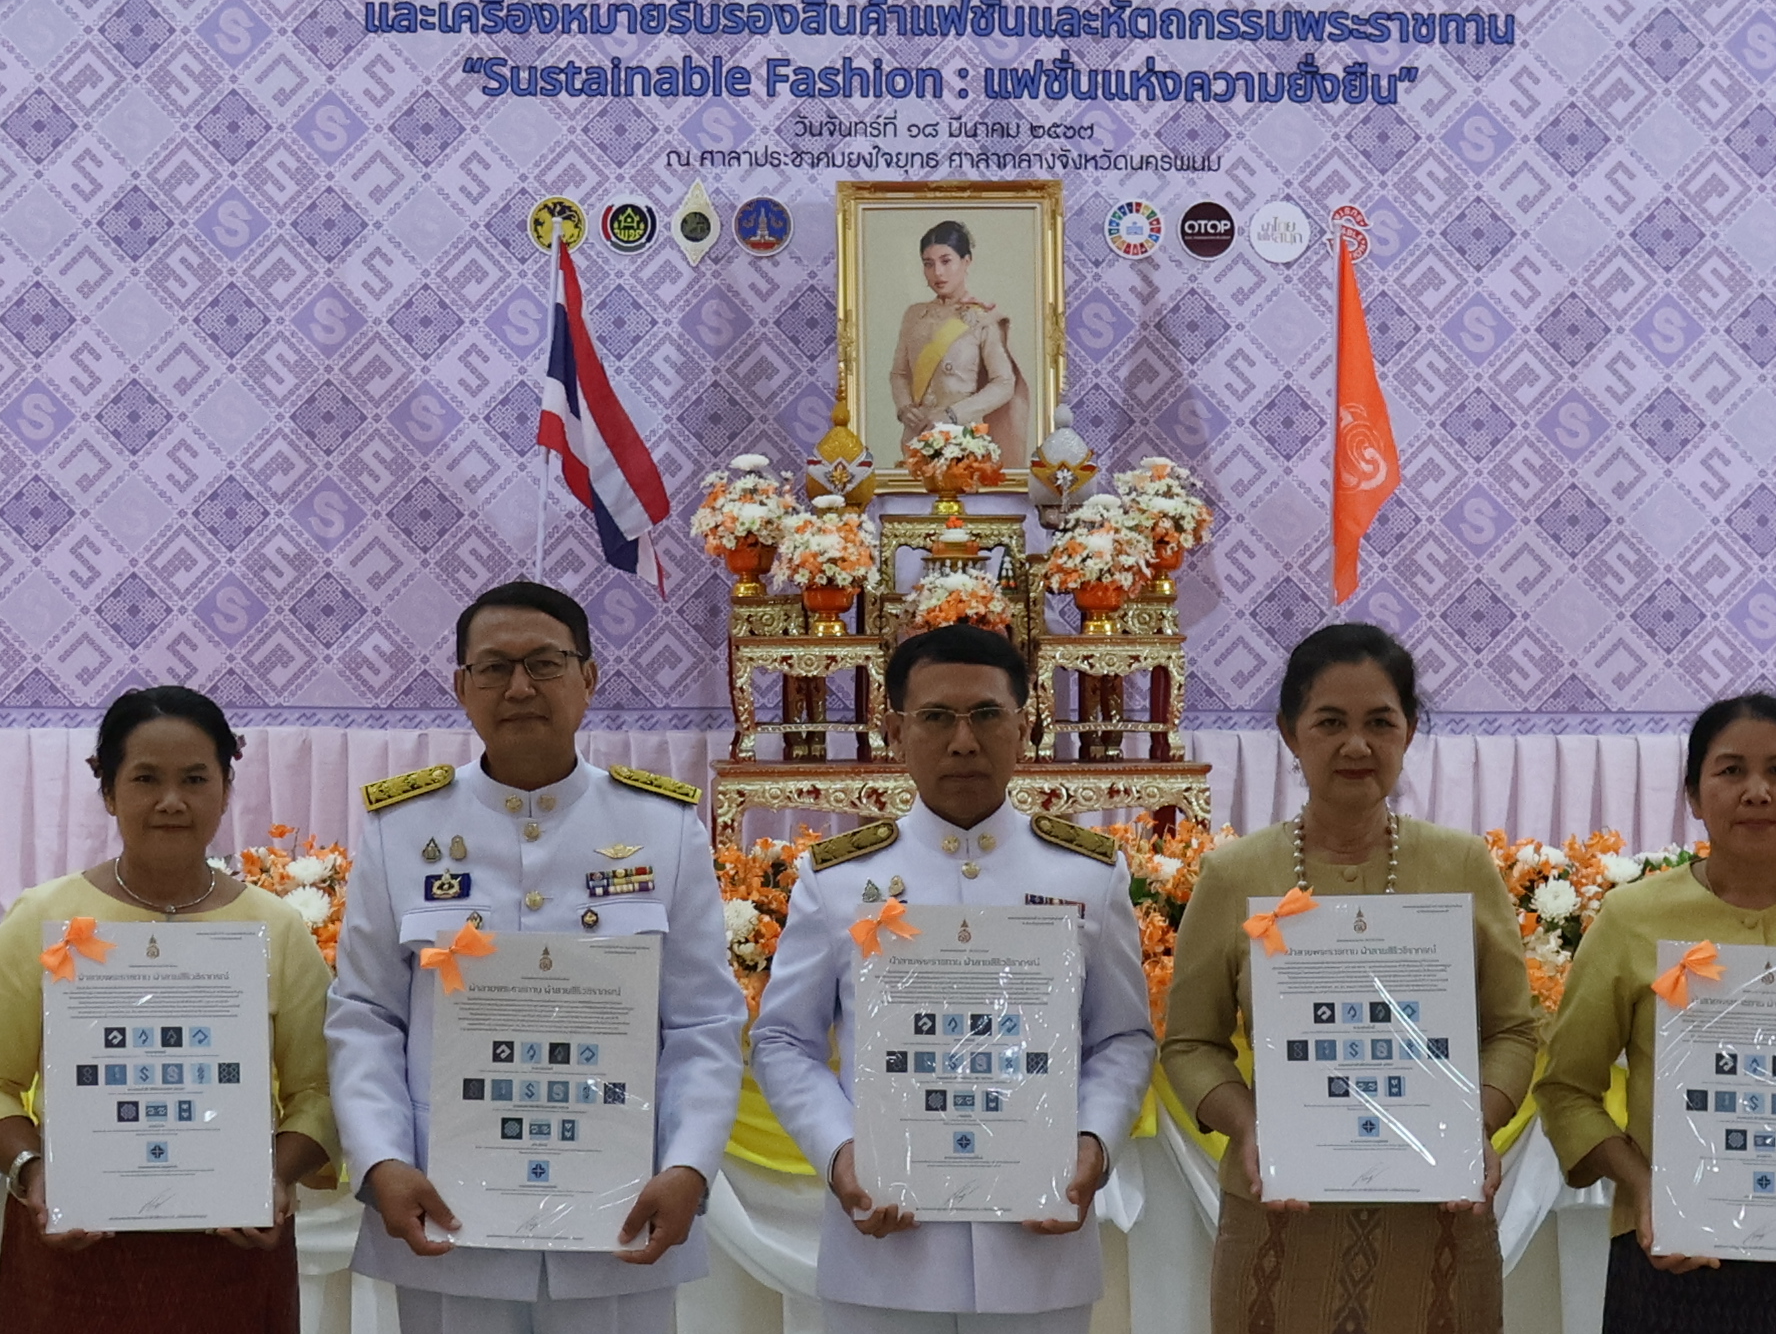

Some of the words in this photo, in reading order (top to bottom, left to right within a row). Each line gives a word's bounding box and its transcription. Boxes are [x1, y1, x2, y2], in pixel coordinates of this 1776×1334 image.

[766, 58, 943, 100] Fashion
[793, 109, 900, 139] วันจันทร์ที่
[906, 123, 940, 139] ๑๘
[948, 116, 1021, 140] มีนาคม
[666, 150, 690, 168] ณ
[1184, 219, 1231, 234] OTOP
